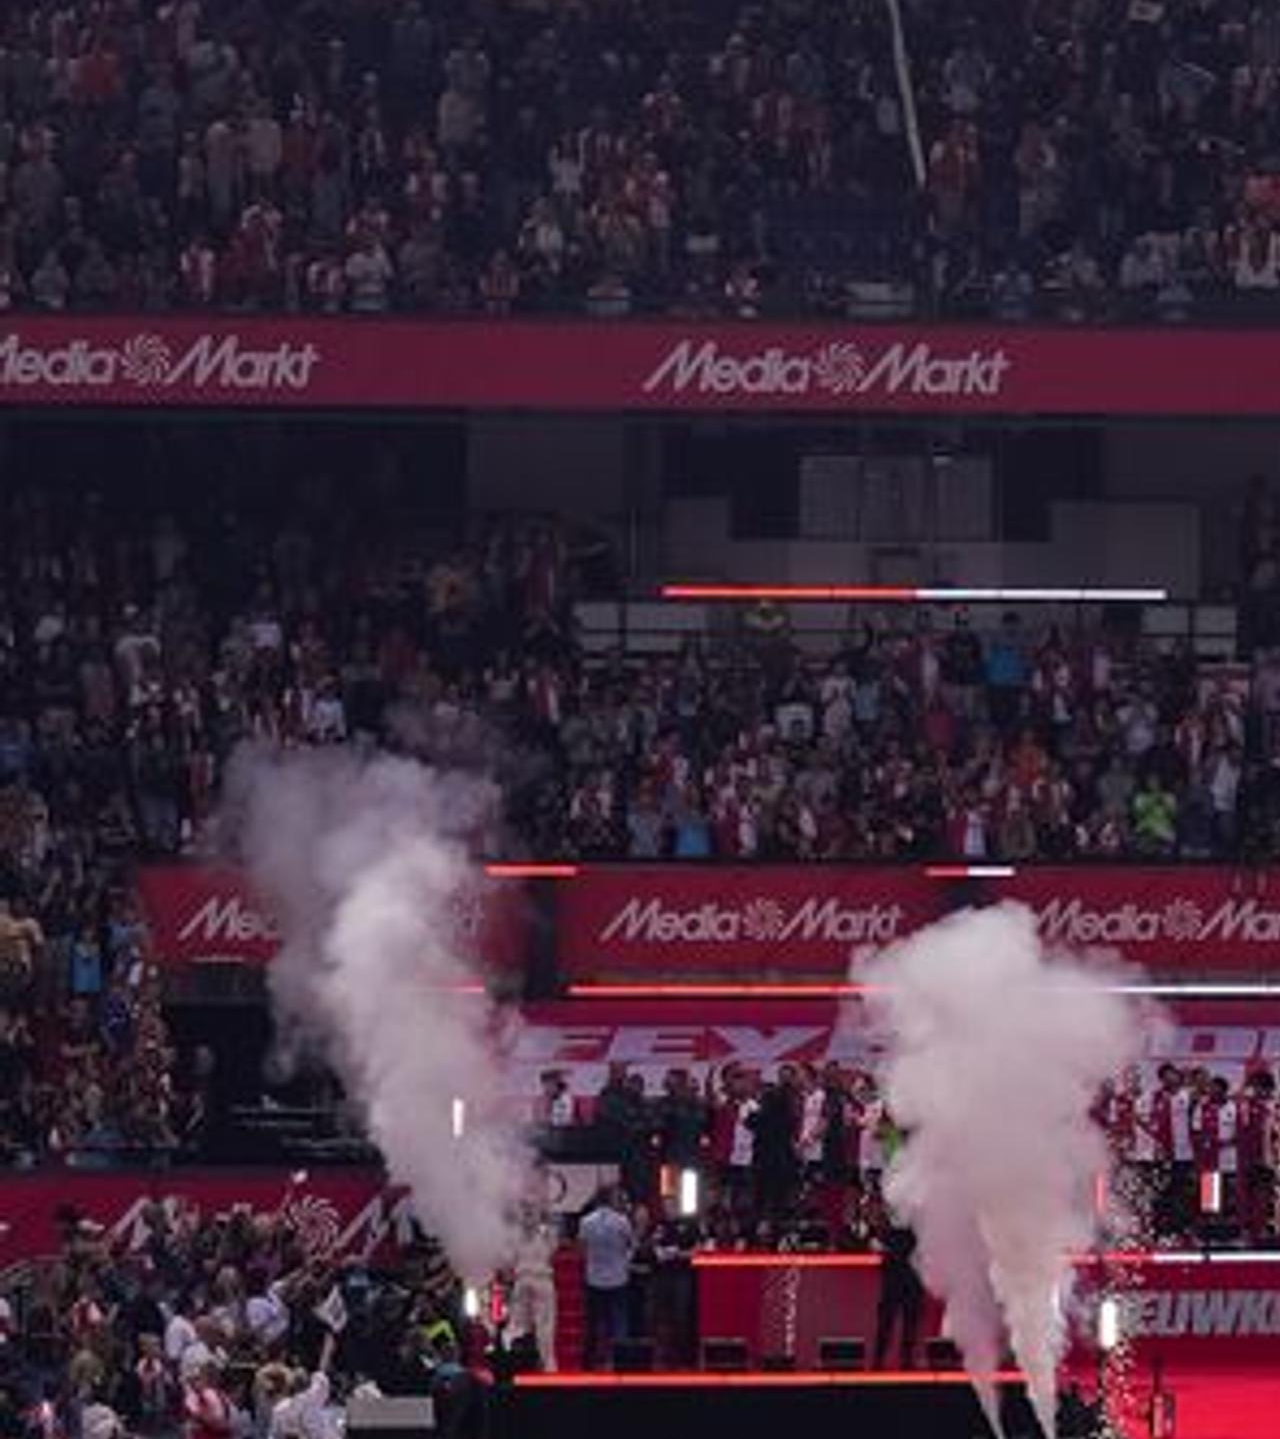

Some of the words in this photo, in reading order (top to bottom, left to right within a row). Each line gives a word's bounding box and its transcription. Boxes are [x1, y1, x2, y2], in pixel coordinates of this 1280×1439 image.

[164, 334, 321, 387] Markt
[643, 340, 810, 392] Media
[856, 343, 1008, 393] Markt
[599, 897, 741, 941] Media
[777, 897, 903, 941] Markt
